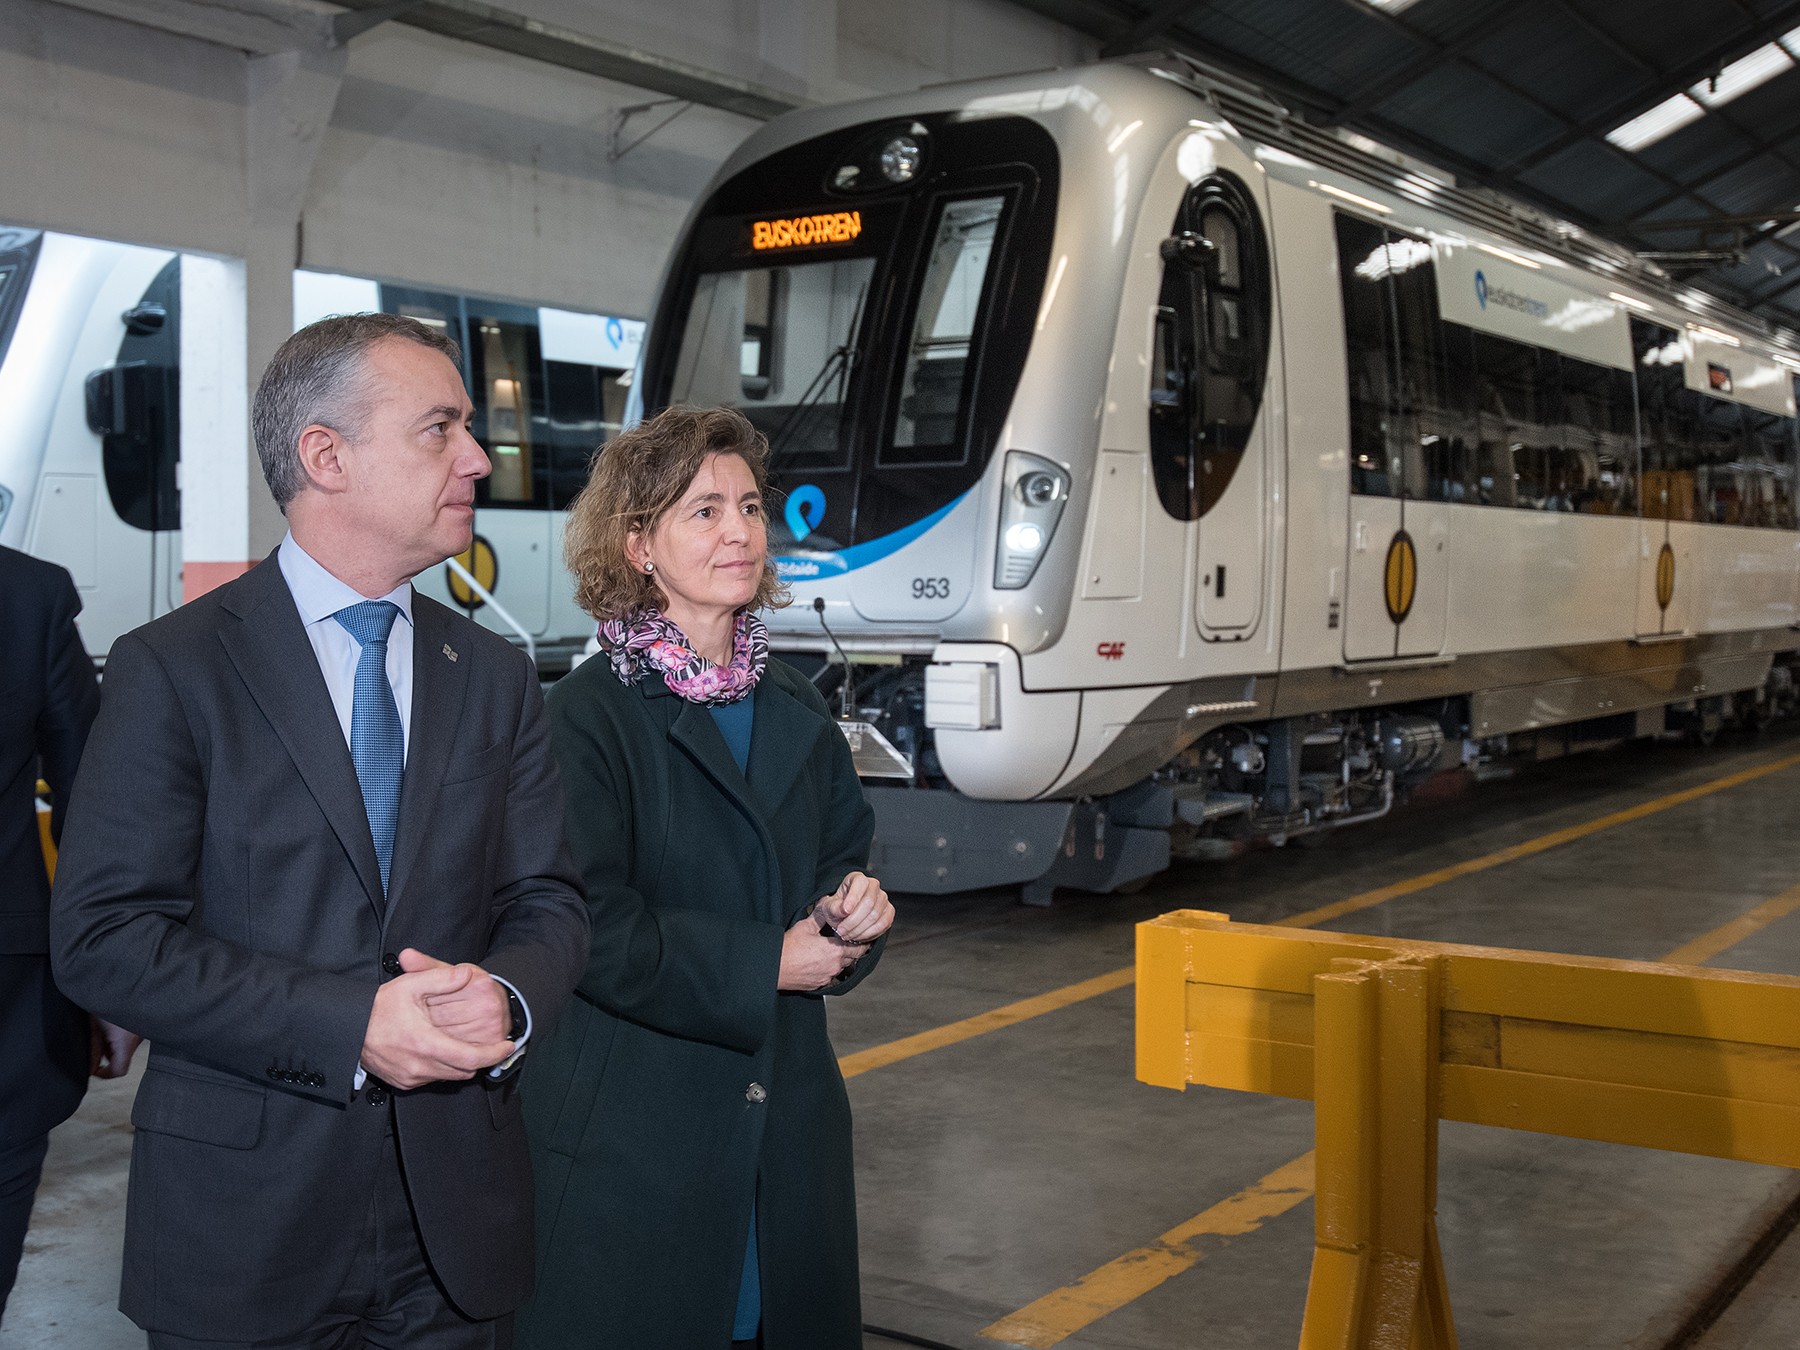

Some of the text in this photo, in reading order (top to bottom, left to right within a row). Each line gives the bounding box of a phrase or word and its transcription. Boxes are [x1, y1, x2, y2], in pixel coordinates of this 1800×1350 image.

[753, 211, 862, 250] EUSKOTREN
[912, 577, 950, 599] 953
[1097, 642, 1125, 660] CAF
